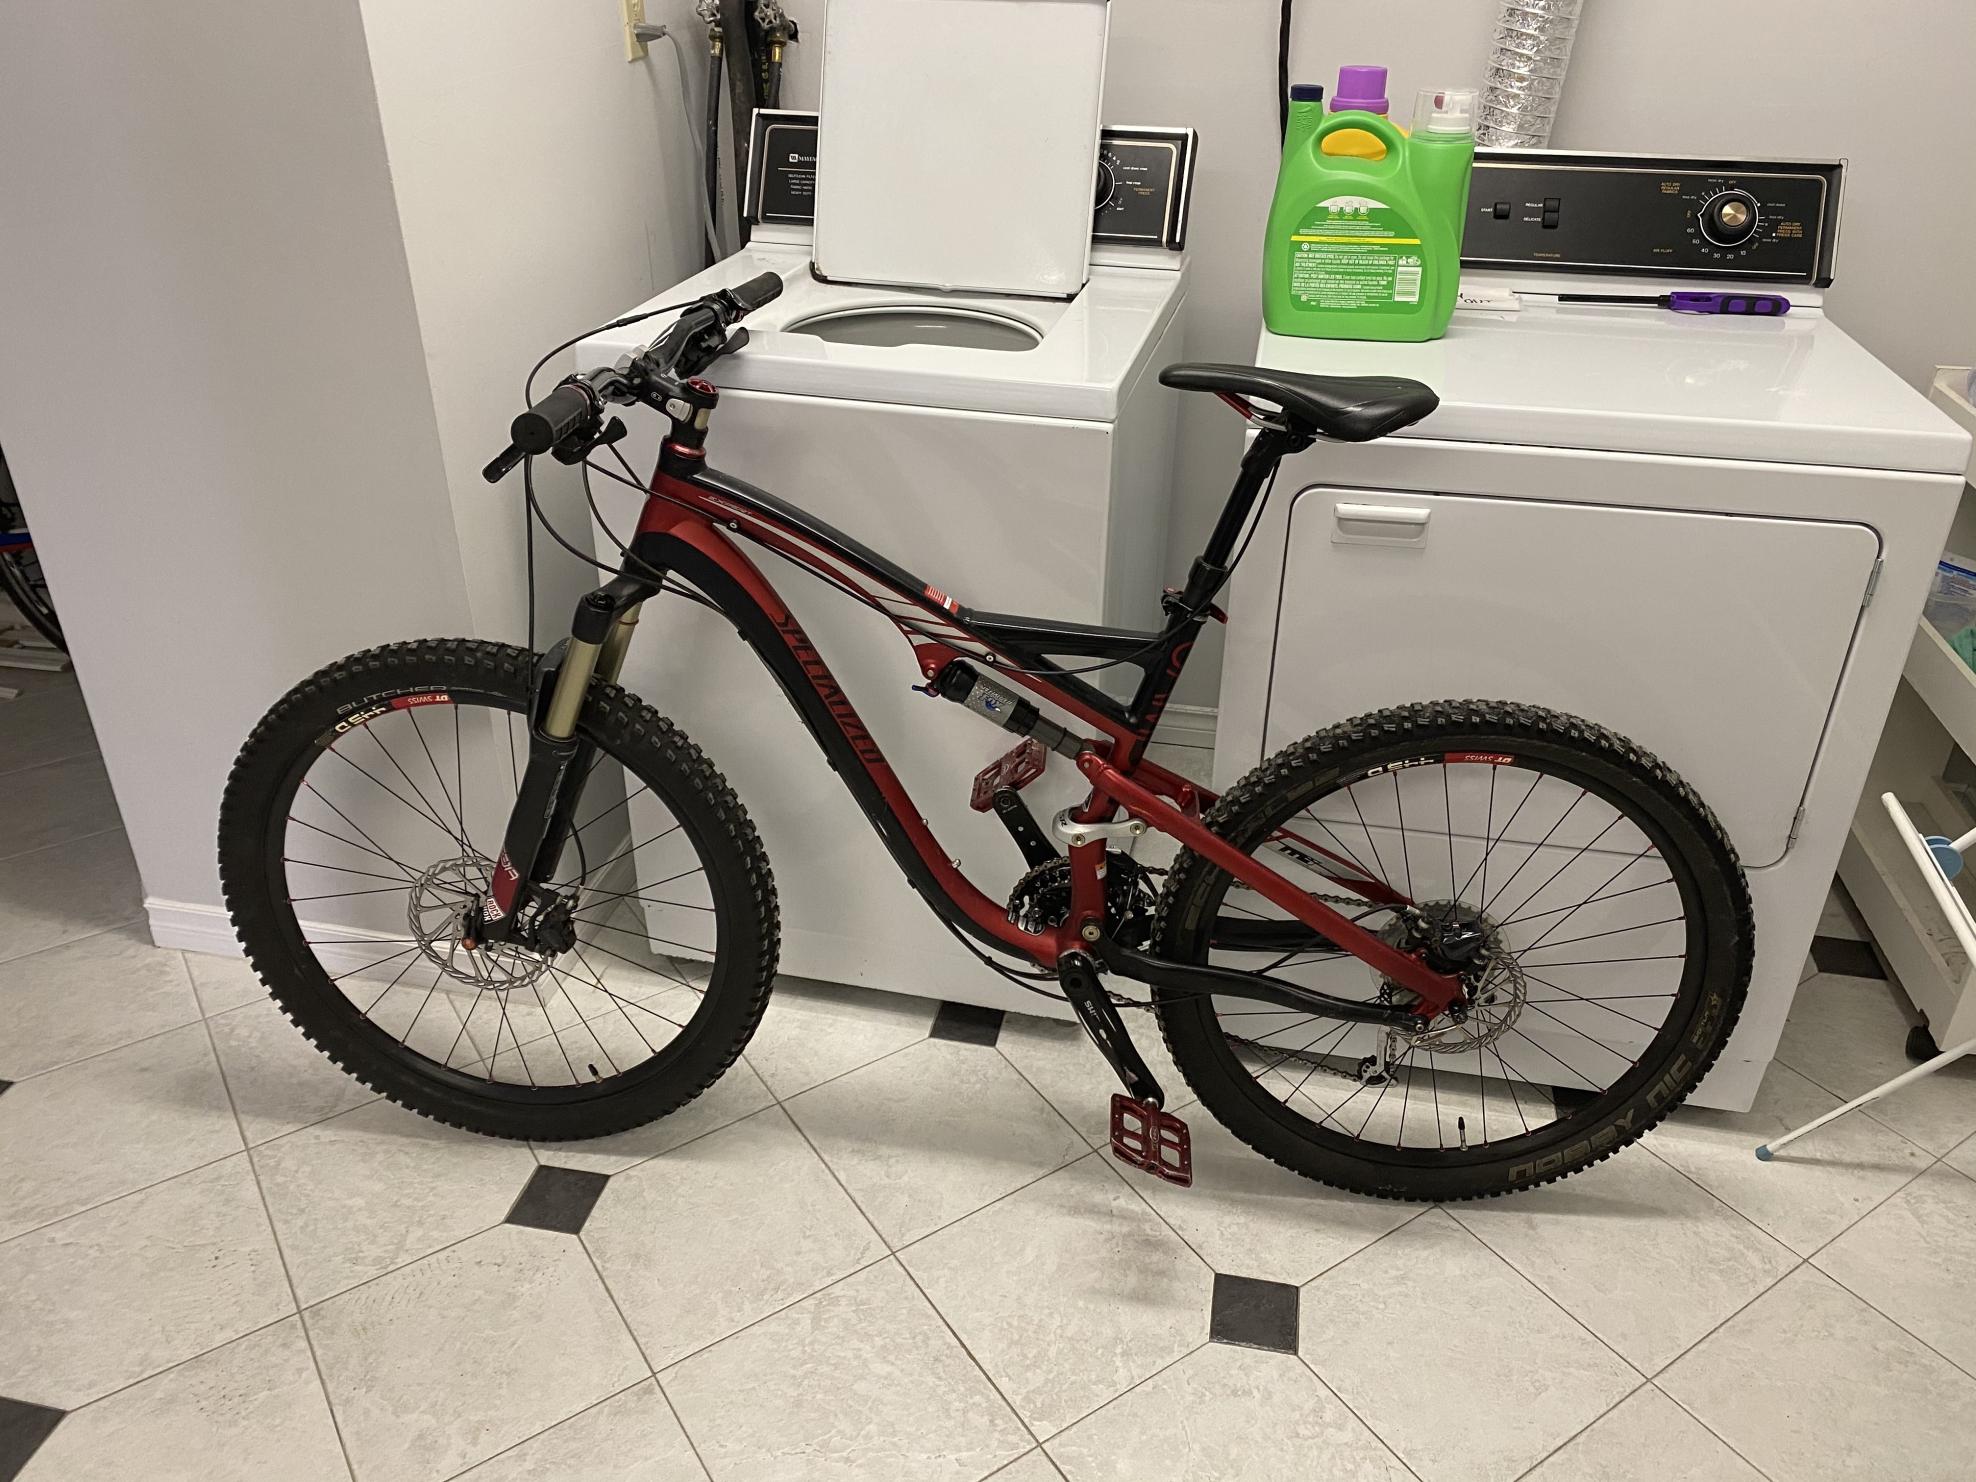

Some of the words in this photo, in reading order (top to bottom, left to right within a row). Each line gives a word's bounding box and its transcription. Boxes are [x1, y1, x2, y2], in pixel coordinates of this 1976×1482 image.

[336, 685, 447, 714] BUTCHER
[407, 696, 433, 704] SWISS
[776, 614, 887, 763] SPECIALIZED
[1464, 754, 1494, 763] SWISS
[487, 898, 504, 920] ROCK
[1646, 1053, 1693, 1108] NIC
